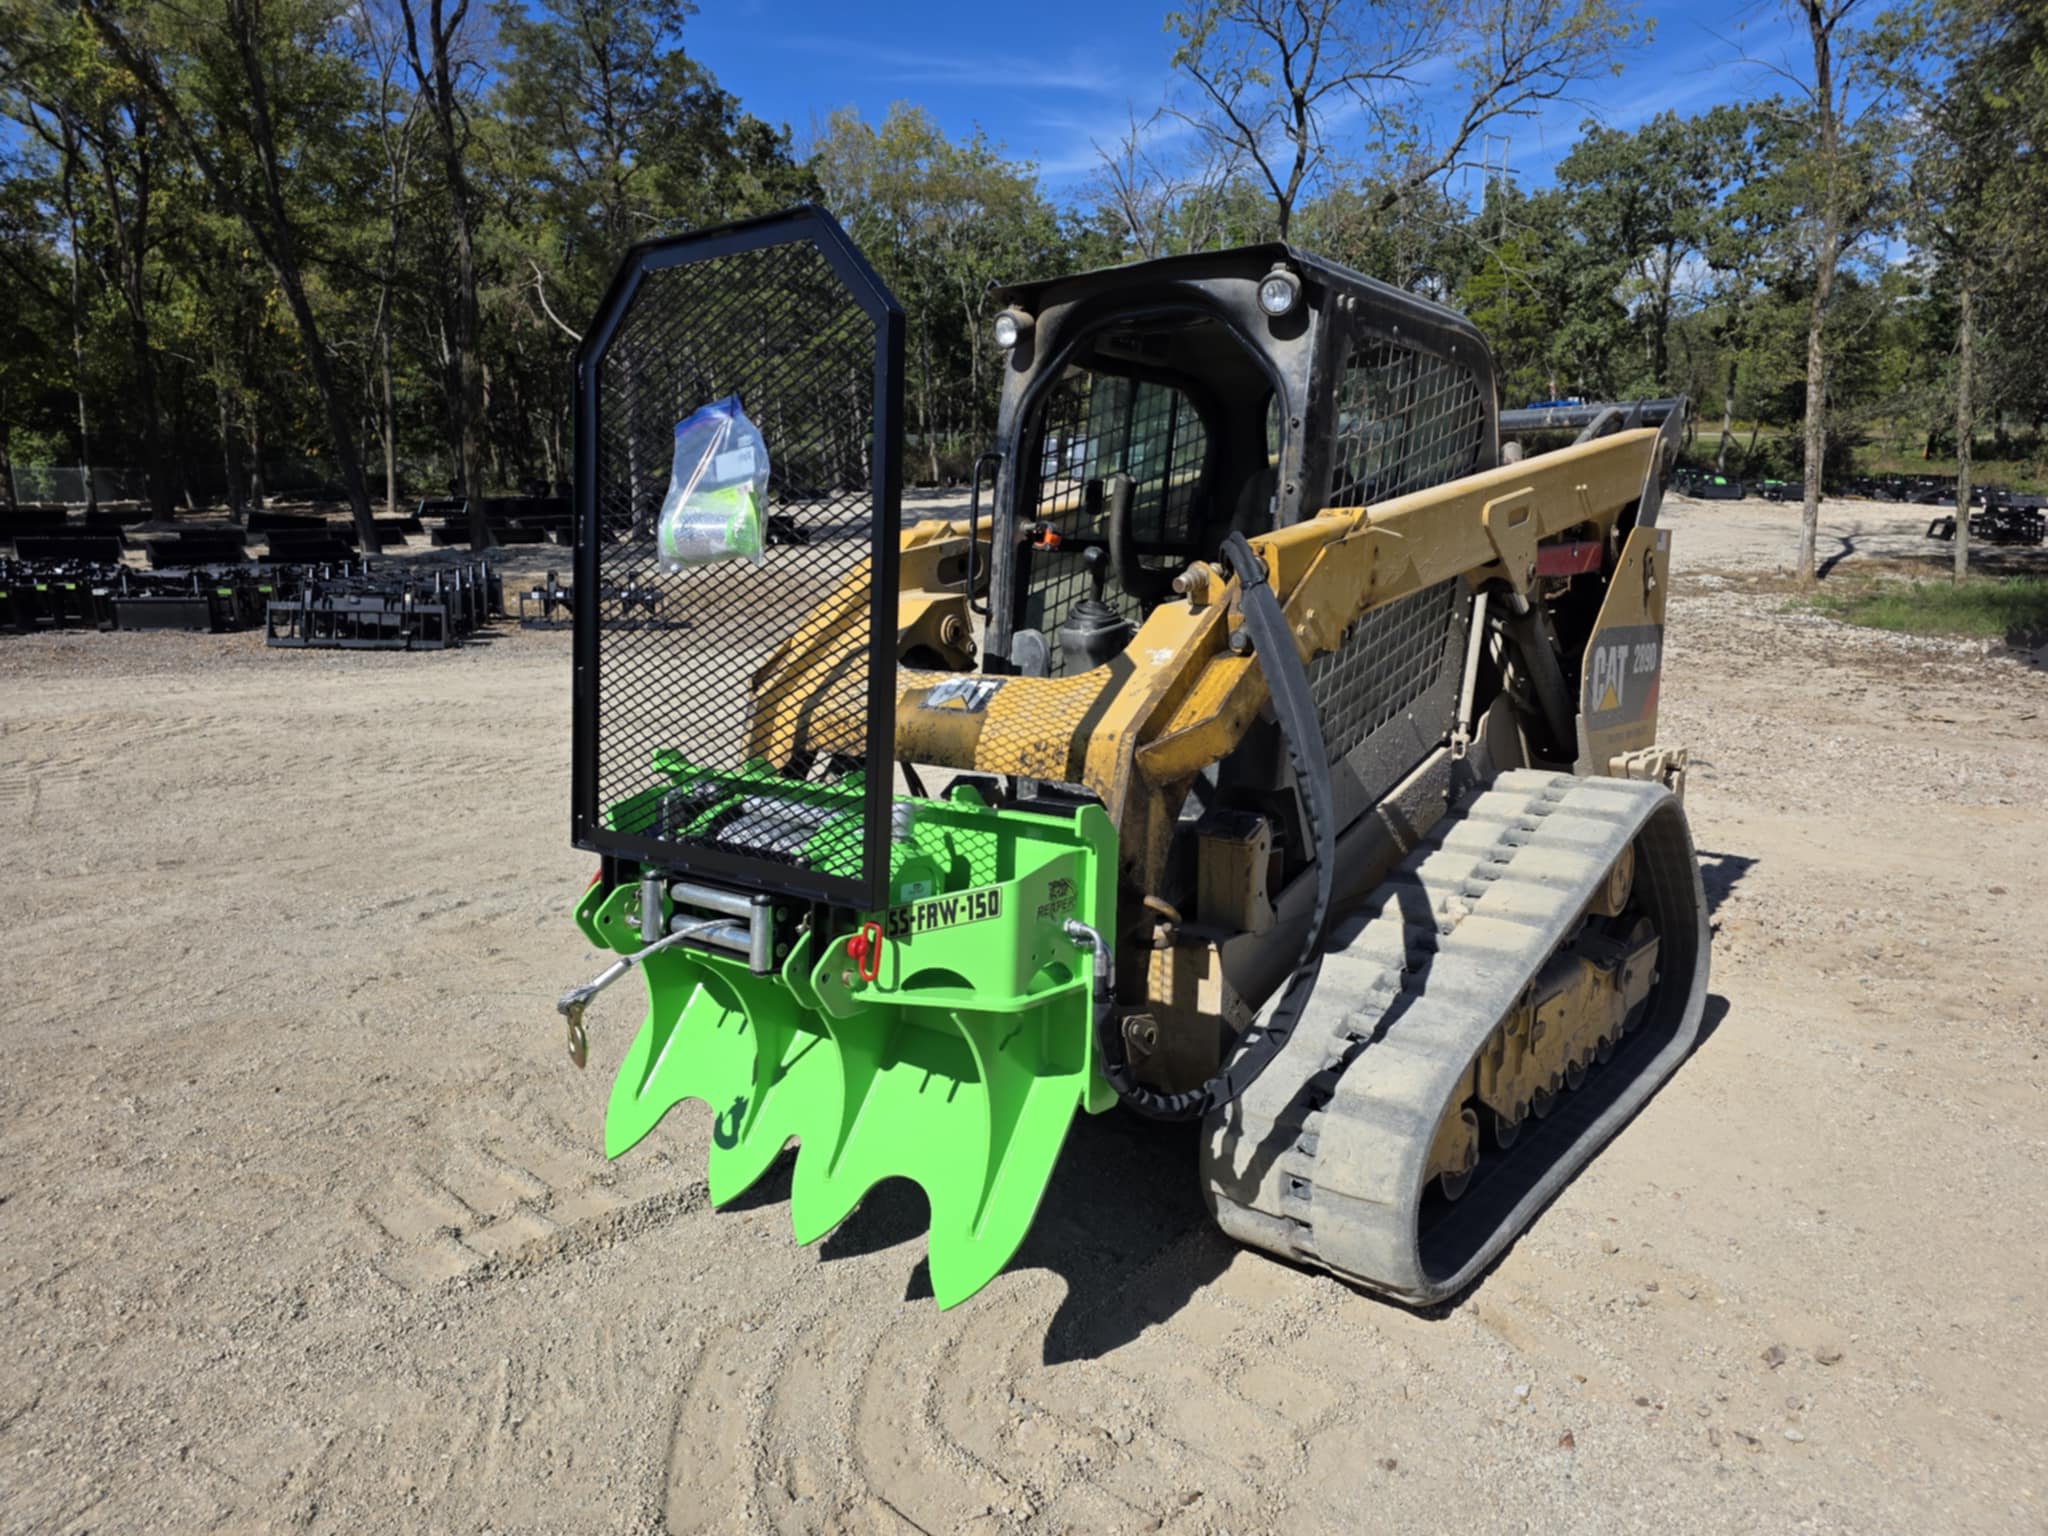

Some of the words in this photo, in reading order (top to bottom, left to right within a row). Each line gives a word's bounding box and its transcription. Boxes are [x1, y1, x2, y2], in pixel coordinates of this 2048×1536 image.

[926, 677, 1000, 711] CAT
[1592, 645, 1629, 711] CAT
[888, 889, 999, 937] SS-FRW-150
